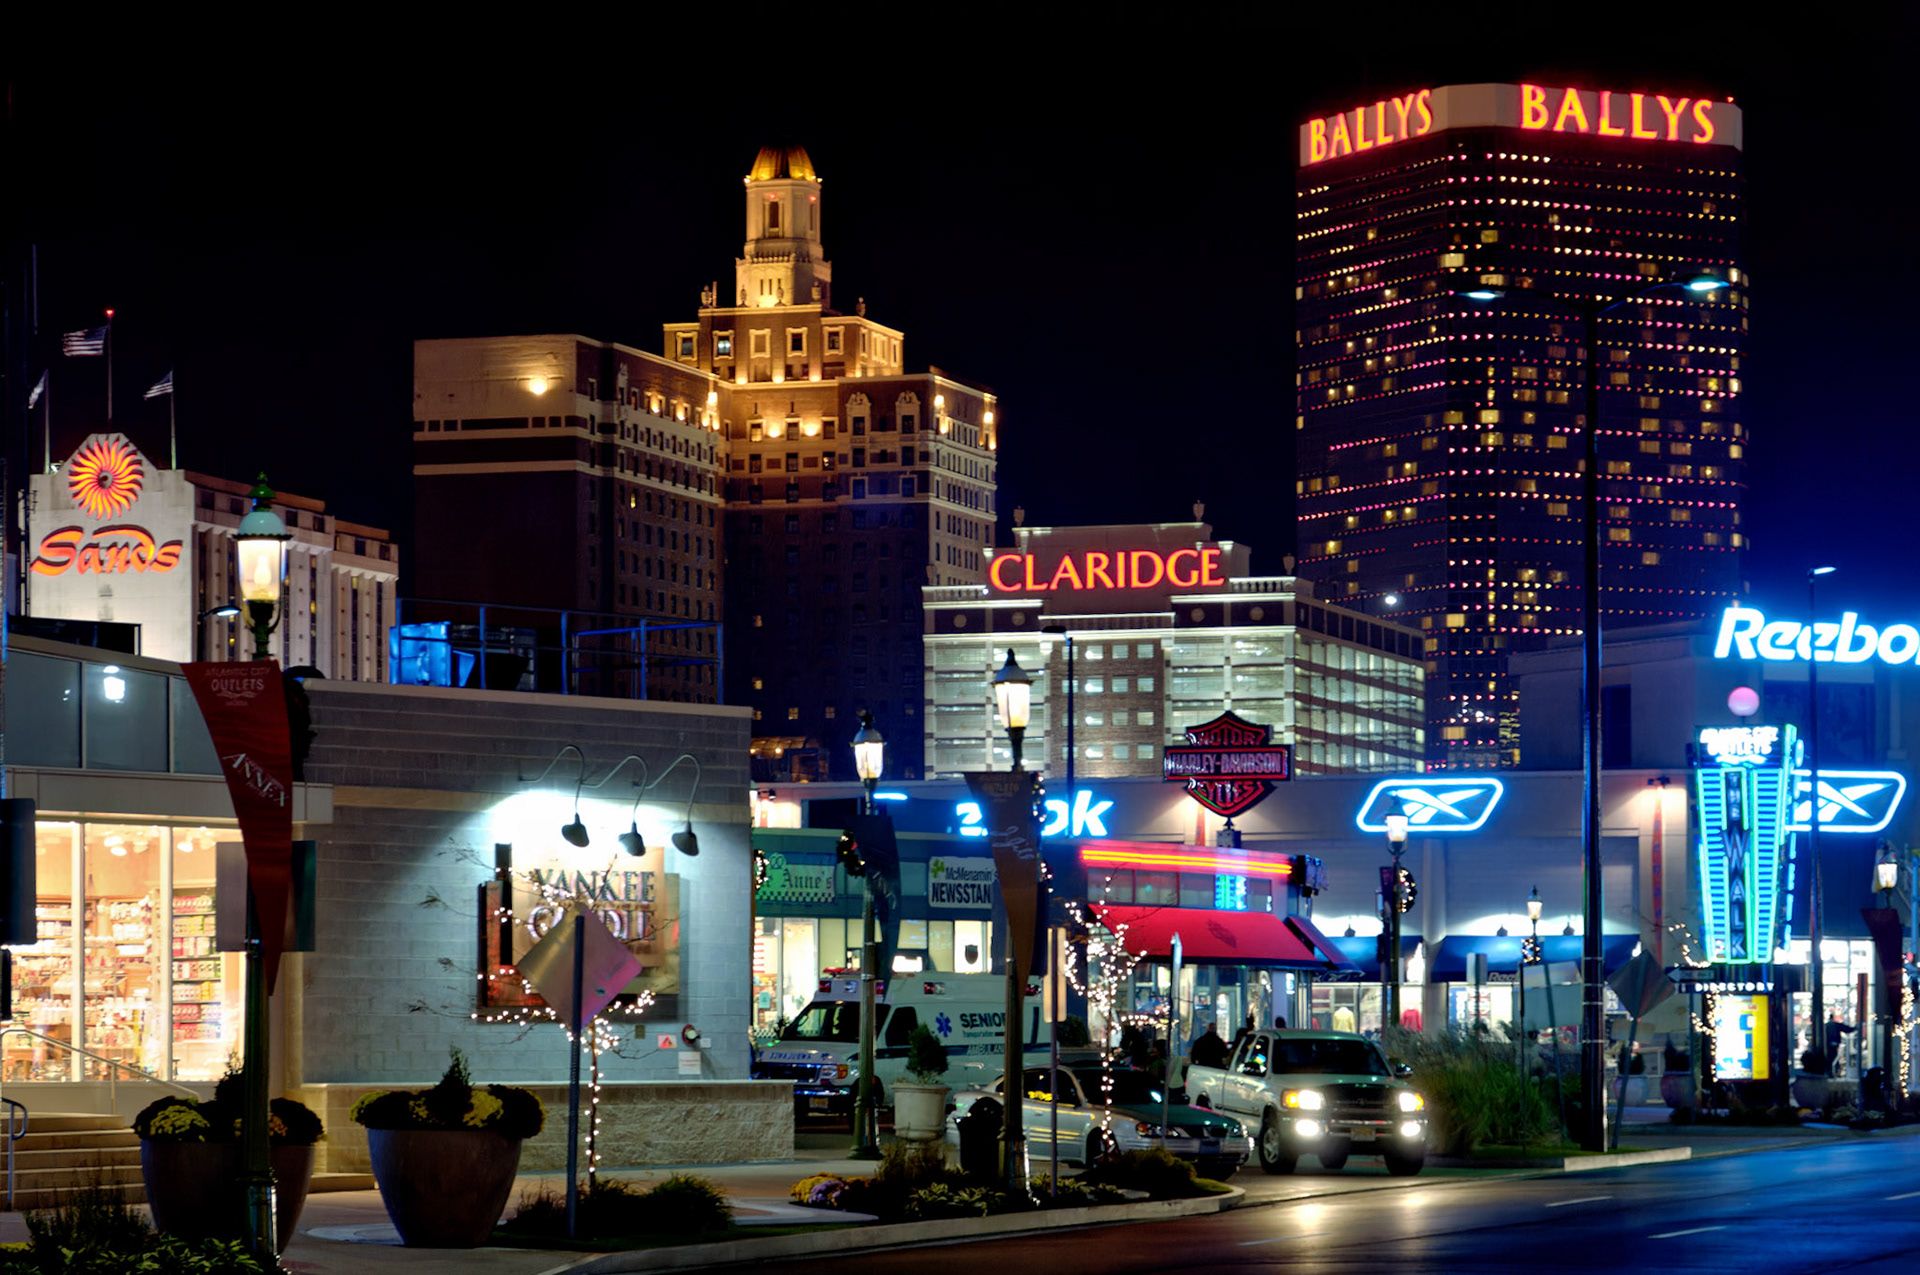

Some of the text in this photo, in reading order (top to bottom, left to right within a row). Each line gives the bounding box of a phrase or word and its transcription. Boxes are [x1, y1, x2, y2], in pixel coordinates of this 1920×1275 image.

[1308, 88, 1434, 164] BALLYS
[1520, 83, 1716, 144] BALLYS
[30, 525, 183, 577] Sands
[989, 548, 1226, 592] CLARIDGE
[1713, 606, 1920, 666] Reebo
[211, 678, 265, 692] OUTLETS
[1171, 752, 1281, 774] HARLEY-DAVIDSON
[532, 868, 656, 903] YANKEE
[779, 867, 833, 890] Anne's
[1722, 829, 1750, 959] WALK
[527, 906, 657, 941] CDLE
[1694, 981, 1775, 992] DIRECTORY
